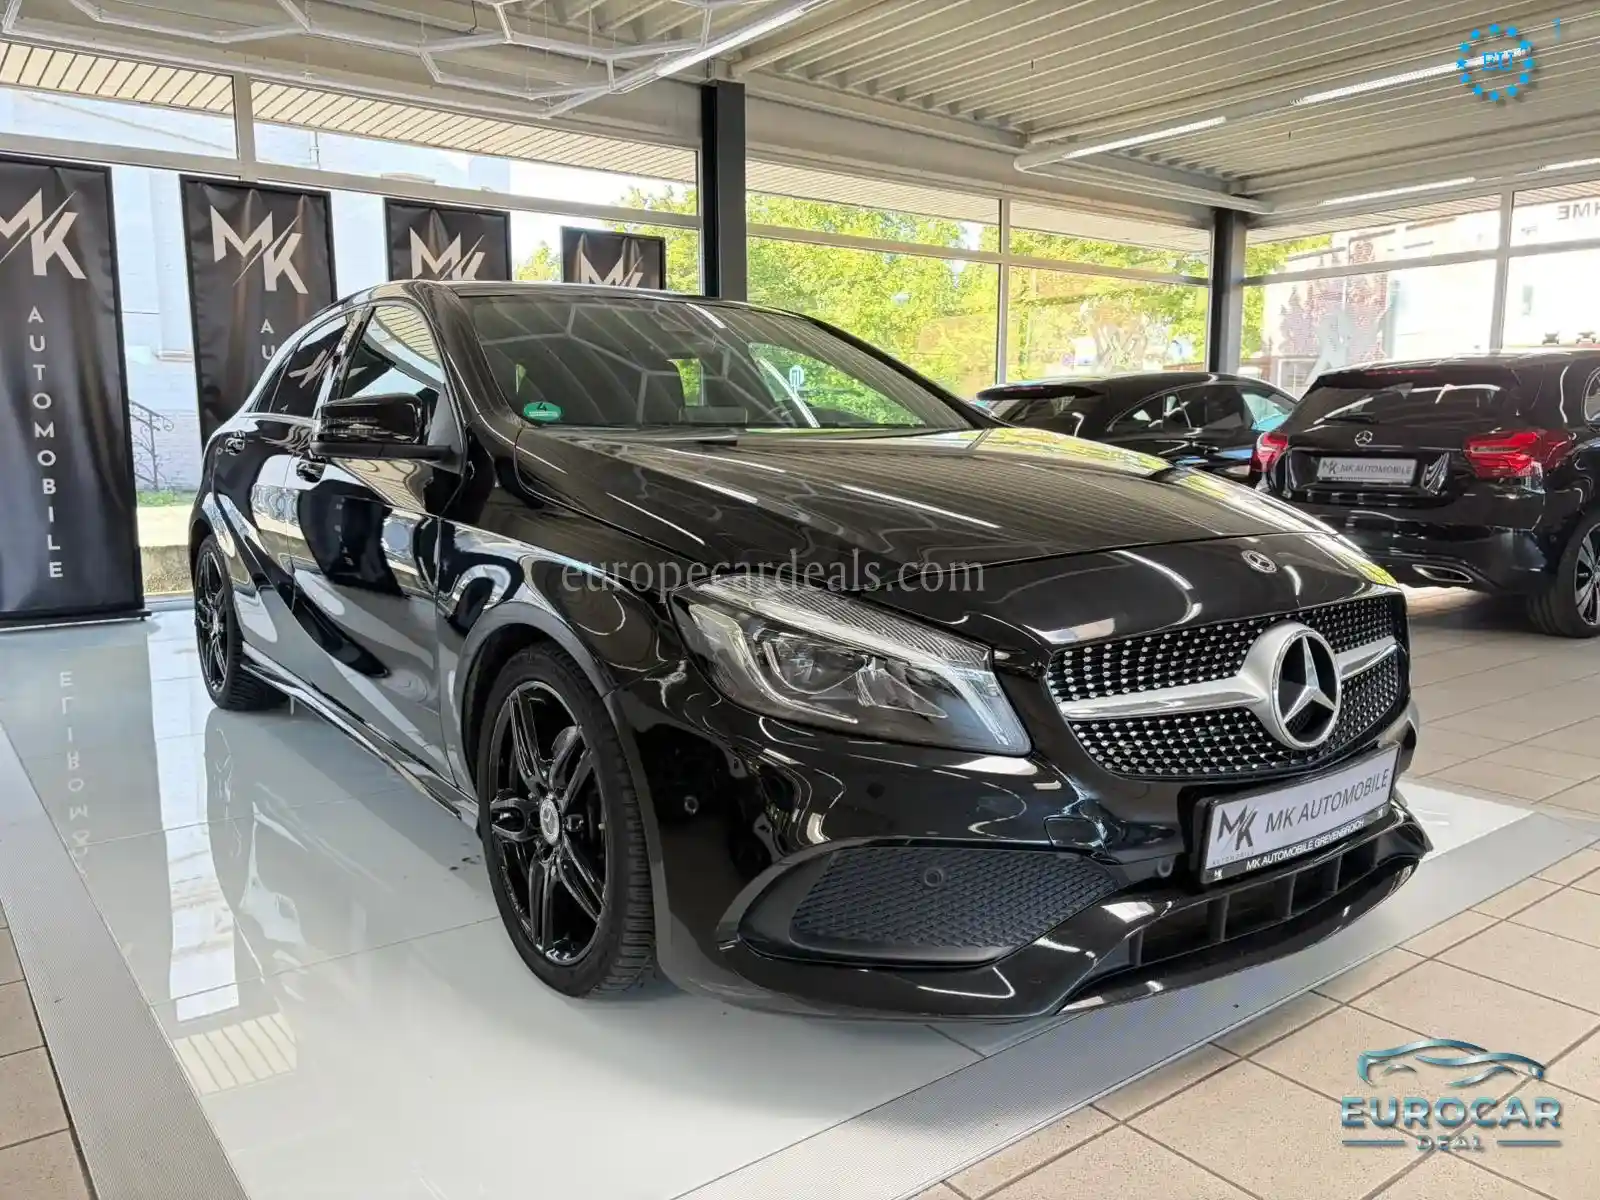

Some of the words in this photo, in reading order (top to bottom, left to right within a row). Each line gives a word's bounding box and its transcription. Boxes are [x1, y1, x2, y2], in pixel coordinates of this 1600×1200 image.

[210, 204, 309, 294] MK
[27, 305, 64, 579] AUTOMOBILE
[1265, 805, 1295, 834] MK
[1298, 768, 1389, 825] AUTOMOBILE
[1246, 857, 1261, 871] MK
[1261, 839, 1313, 867] AUTOMOBILE
